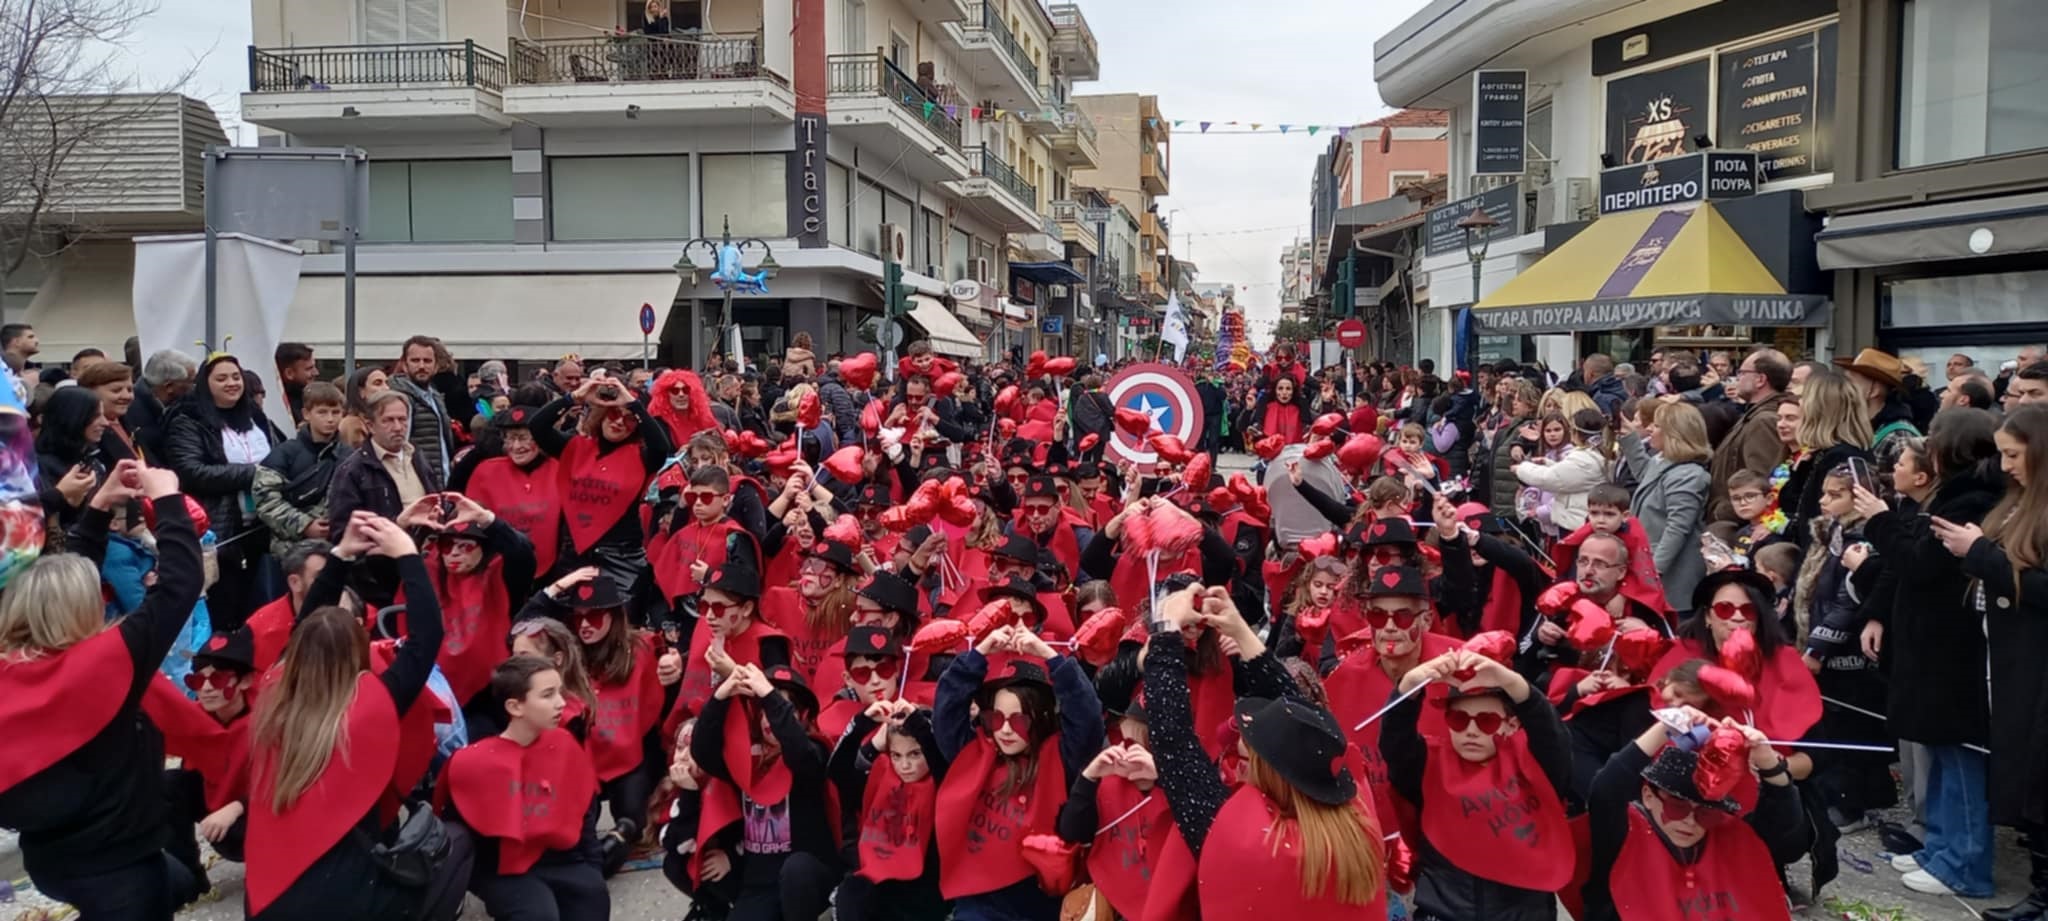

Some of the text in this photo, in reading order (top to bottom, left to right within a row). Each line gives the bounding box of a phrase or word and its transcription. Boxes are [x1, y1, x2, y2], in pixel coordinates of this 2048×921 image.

[1648, 98, 1673, 123] XS
[1751, 113, 1802, 134] CIGARETTES
[801, 117, 820, 233] Trace
[1715, 159, 1748, 172] ΠΟΤΑ
[1711, 178, 1752, 191] ΠΟΥΡΑ
[1605, 181, 1698, 211] ΠΕΡΙΠΤΕΡΟ
[1533, 307, 1583, 325] ΠΟΥΡΑ
[1587, 299, 1700, 323] ΑΝΑΨΥΚΤΙΚΑ
[1733, 299, 1805, 320] ΨΙΛΙΚΑ
[762, 841, 792, 854] GAME
